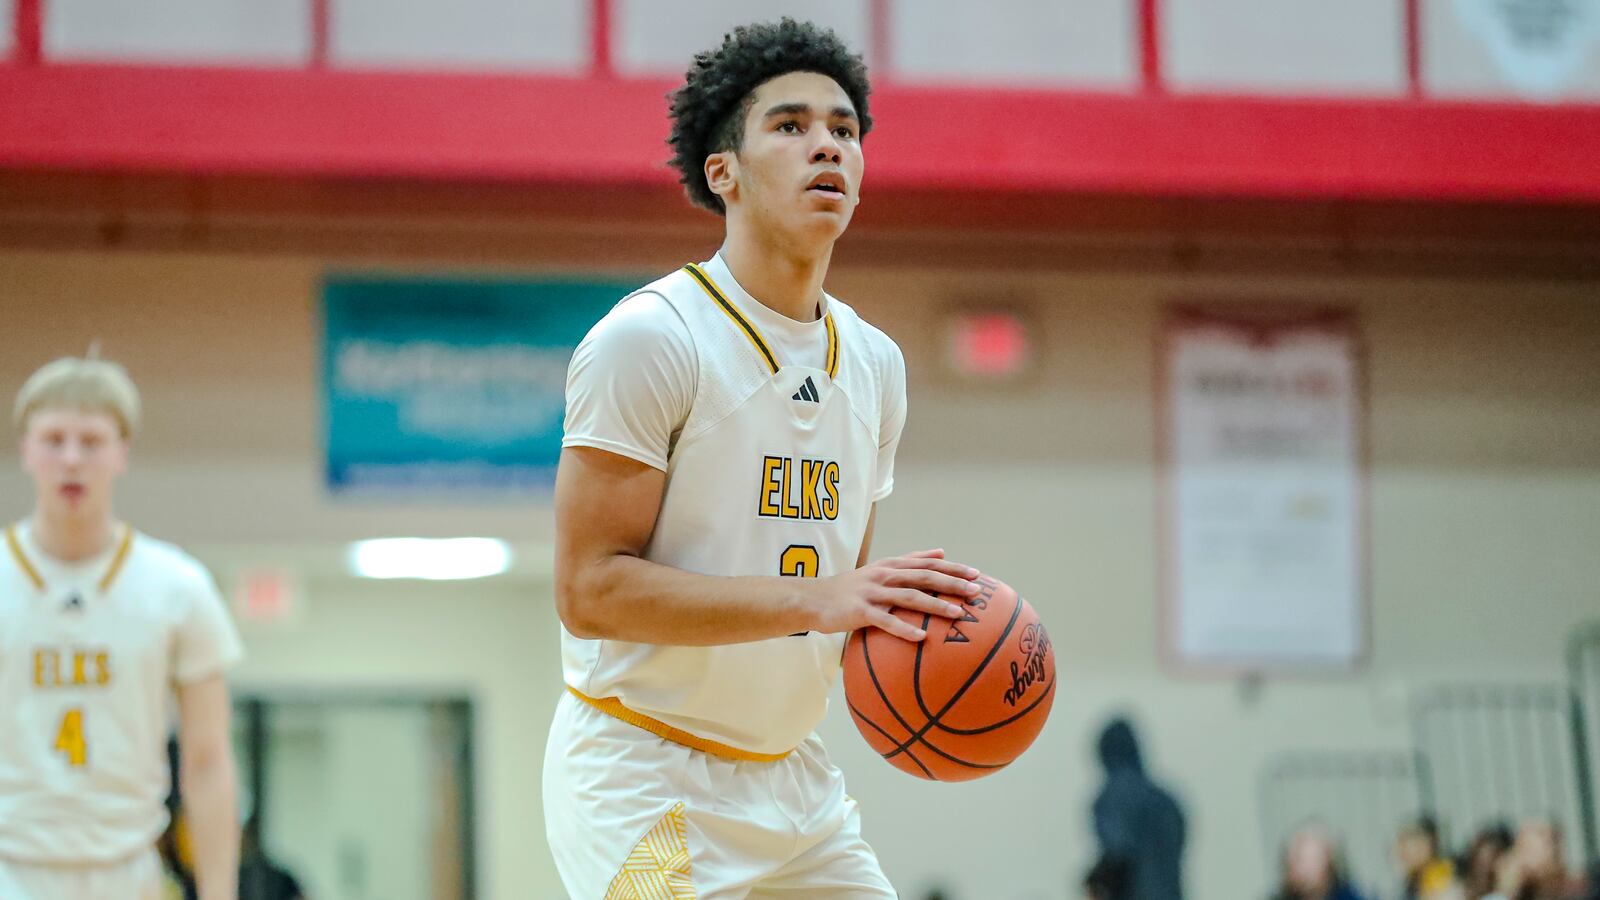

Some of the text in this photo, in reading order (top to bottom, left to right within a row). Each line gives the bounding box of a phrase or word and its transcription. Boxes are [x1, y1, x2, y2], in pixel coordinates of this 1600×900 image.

[758, 456, 840, 520] ELKS
[33, 648, 112, 688] ELKS
[54, 707, 87, 766] 4
